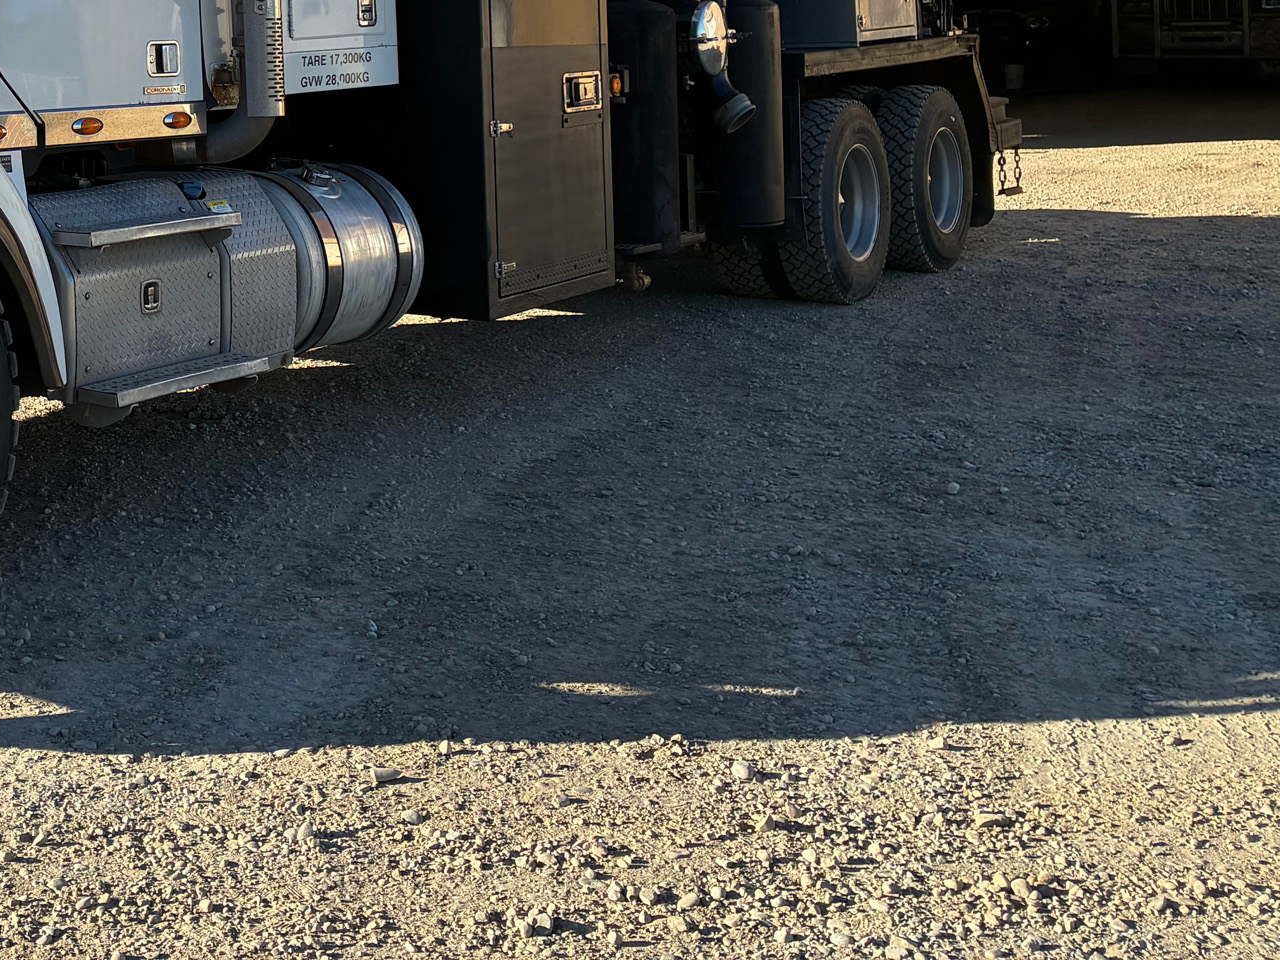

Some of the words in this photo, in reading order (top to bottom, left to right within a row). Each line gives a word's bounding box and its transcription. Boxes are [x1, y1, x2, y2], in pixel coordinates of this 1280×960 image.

[301, 54, 327, 67] TARE
[329, 51, 372, 66] 17,300KG
[300, 75, 323, 88] GVW
[325, 71, 370, 87] 28,000KG
